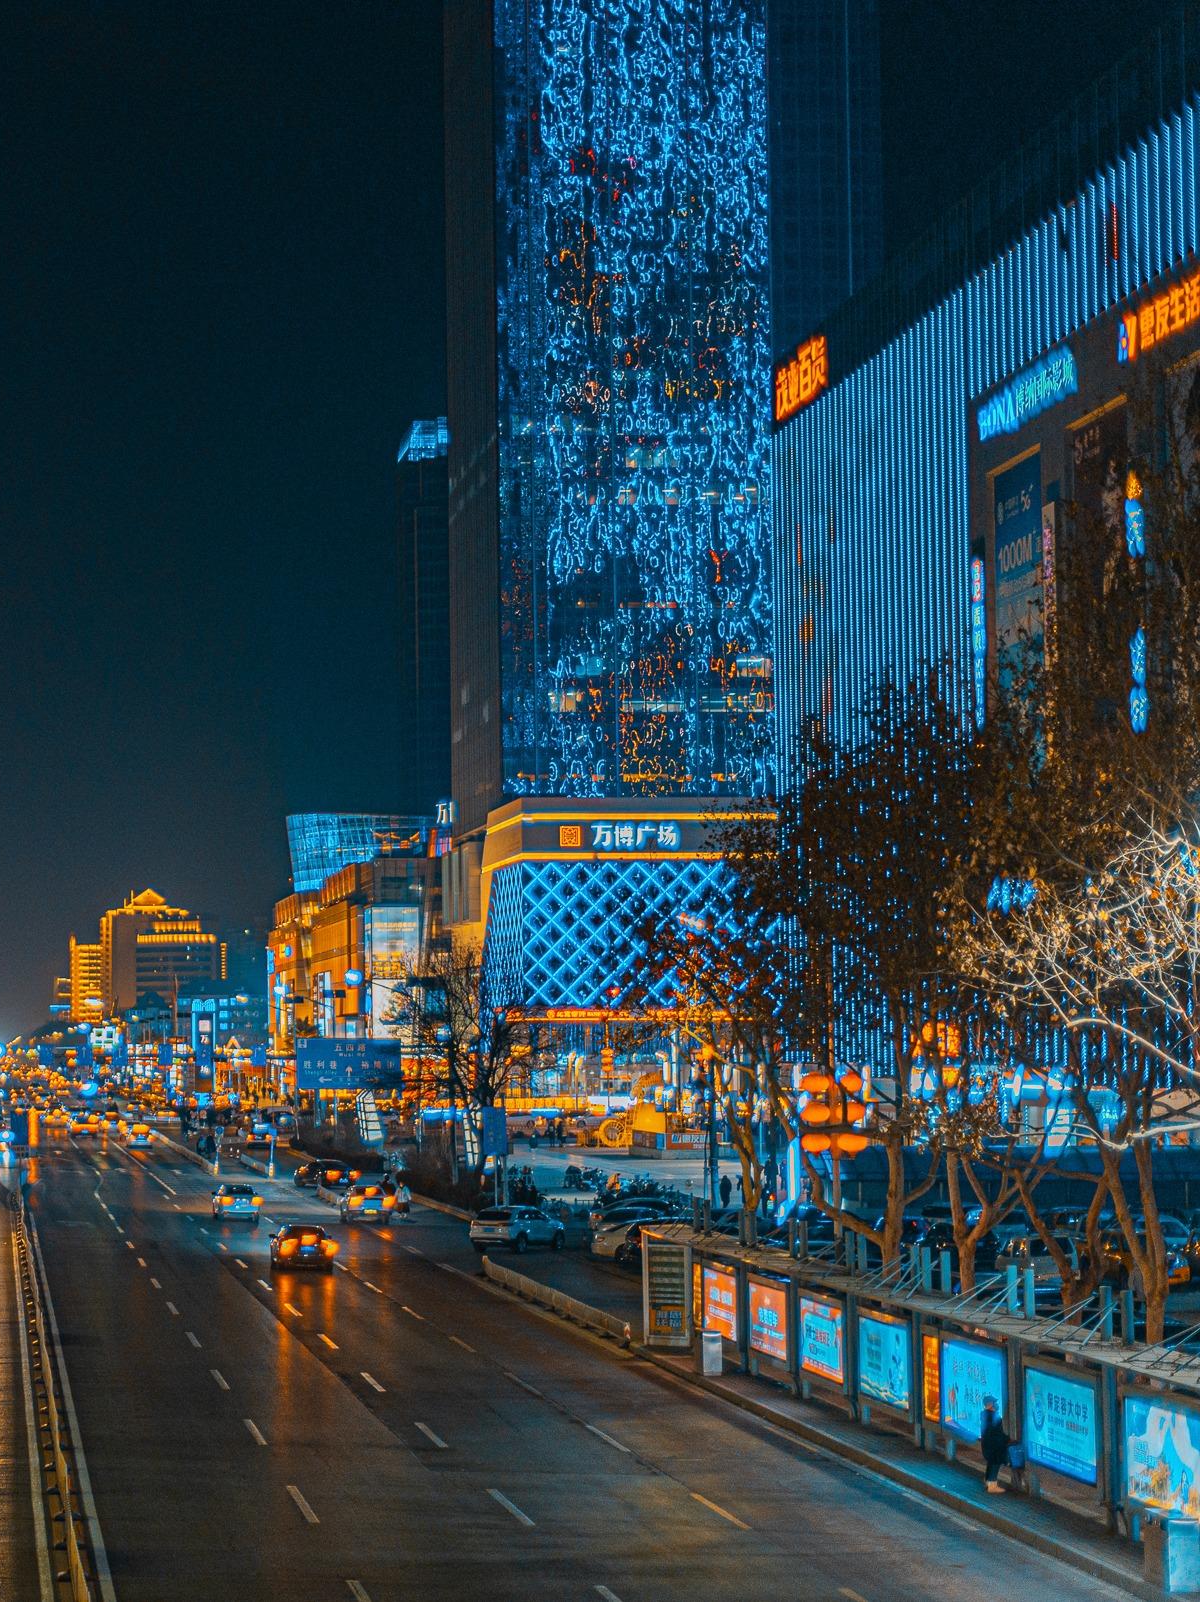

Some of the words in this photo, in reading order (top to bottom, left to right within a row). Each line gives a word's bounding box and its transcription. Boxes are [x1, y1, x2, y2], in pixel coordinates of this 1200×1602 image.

[776, 336, 825, 420] 茂业百货
[435, 801, 453, 825] 万
[591, 824, 678, 847] 万博广场
